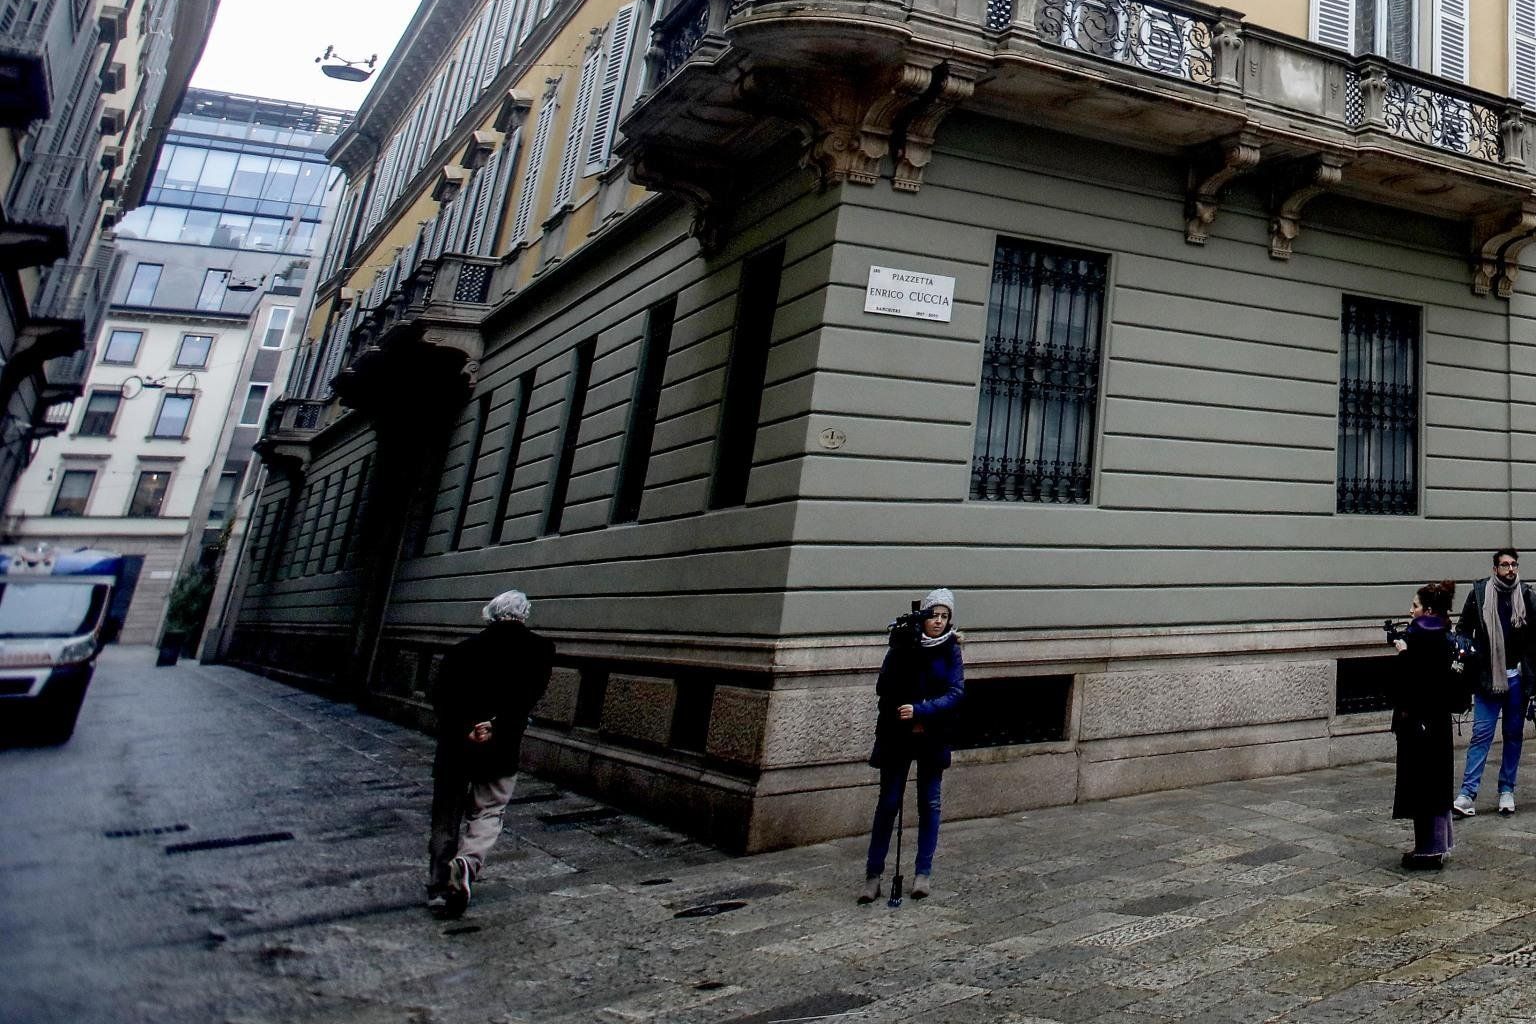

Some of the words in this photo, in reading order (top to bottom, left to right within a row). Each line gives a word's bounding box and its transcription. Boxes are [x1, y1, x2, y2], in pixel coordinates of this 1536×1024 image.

[892, 273, 934, 286] PIAZZETTA
[870, 287, 904, 300] ENRICO
[909, 291, 950, 306] CUCCIA
